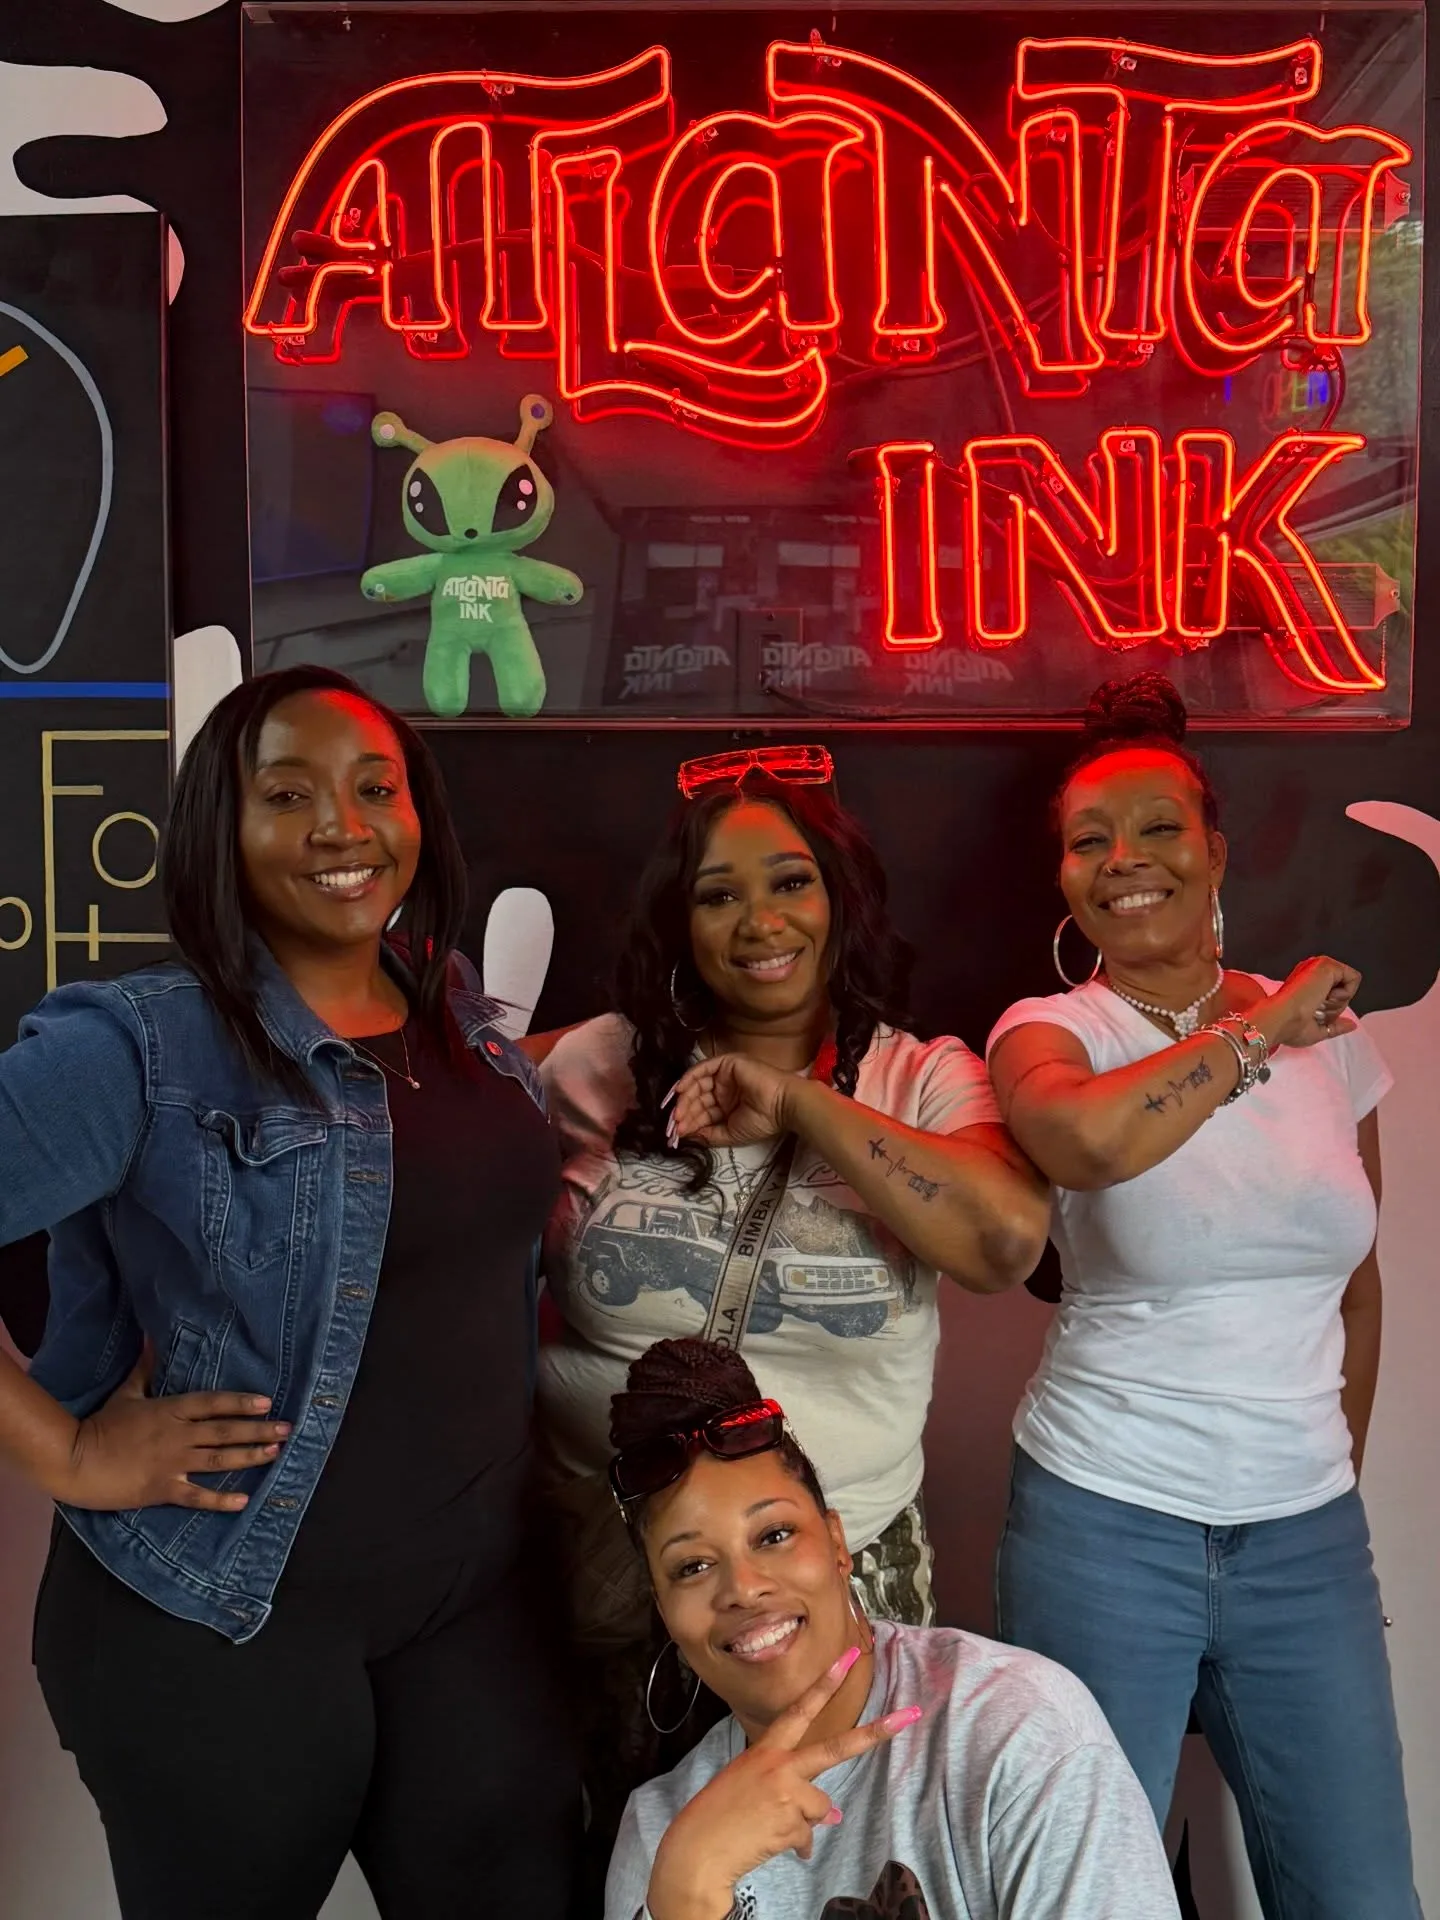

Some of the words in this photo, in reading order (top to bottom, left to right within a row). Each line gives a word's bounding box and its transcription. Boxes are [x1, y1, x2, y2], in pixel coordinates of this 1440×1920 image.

[877, 428, 1387, 691] INK
[460, 603, 493, 623] INK
[738, 1196, 773, 1257] BIMBA
